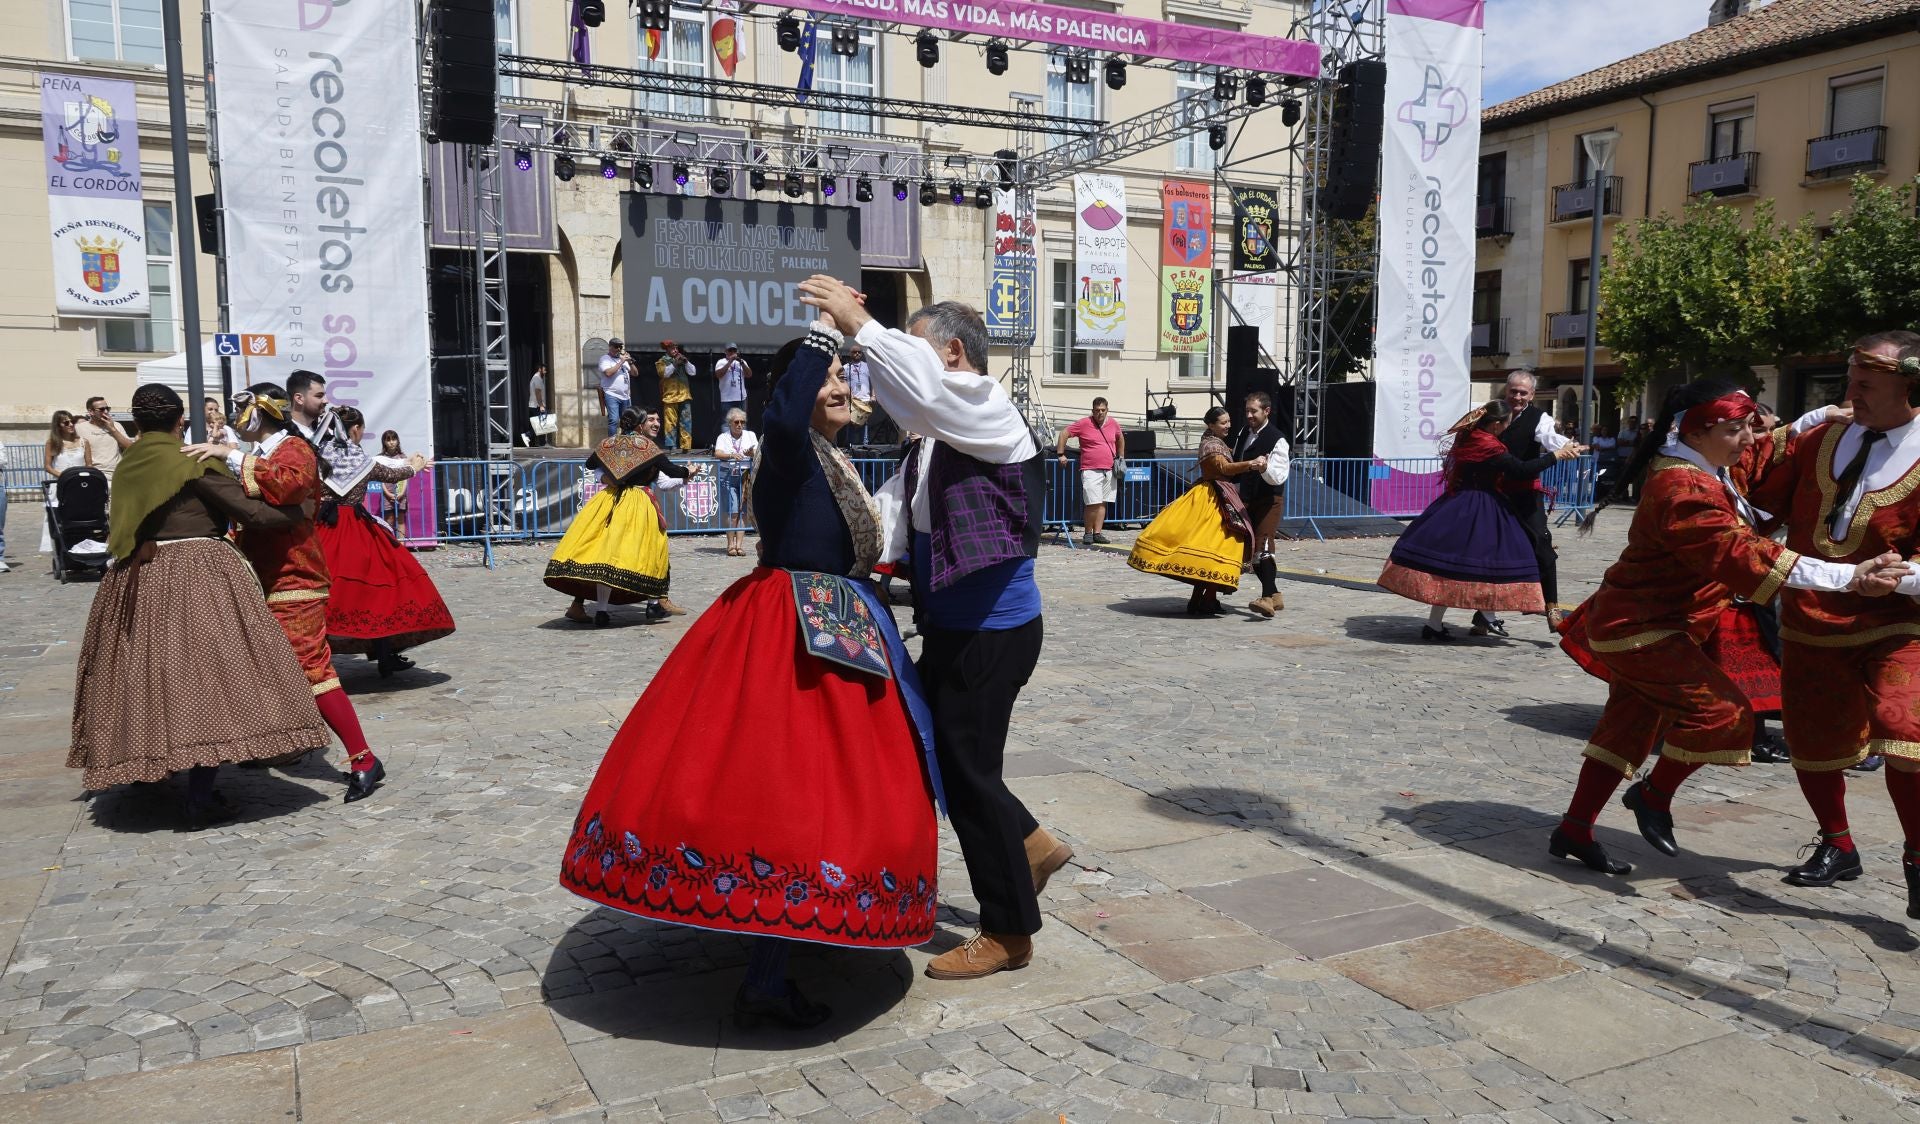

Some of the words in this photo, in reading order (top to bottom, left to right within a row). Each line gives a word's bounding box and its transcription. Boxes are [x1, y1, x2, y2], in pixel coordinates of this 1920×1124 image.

[954, 4, 1005, 27] VIDA.
[1010, 10, 1052, 33] MÁS
[1056, 18, 1147, 46] PALENCIA
[42, 77, 82, 92] PEÑA
[51, 175, 67, 188] EL
[73, 177, 140, 192] CORDÓN
[308, 51, 368, 294] recoletas
[1248, 190, 1256, 199] EL
[53, 220, 83, 239] PEÑA
[655, 218, 738, 247] FESTIVAL
[741, 223, 830, 252] NACIONAL
[1078, 235, 1092, 249] EL
[654, 243, 680, 269] DE
[683, 245, 775, 273] FOLKLORE
[781, 256, 829, 271] PALENCIA
[1090, 262, 1117, 275] PEÑA
[1421, 175, 1446, 340] recoletas
[1170, 268, 1205, 283] PEÑA
[66, 287, 90, 303] SAN
[644, 276, 672, 323] A
[289, 306, 305, 370] PERS
[322, 314, 376, 441] salu
[1417, 353, 1442, 441] salud
